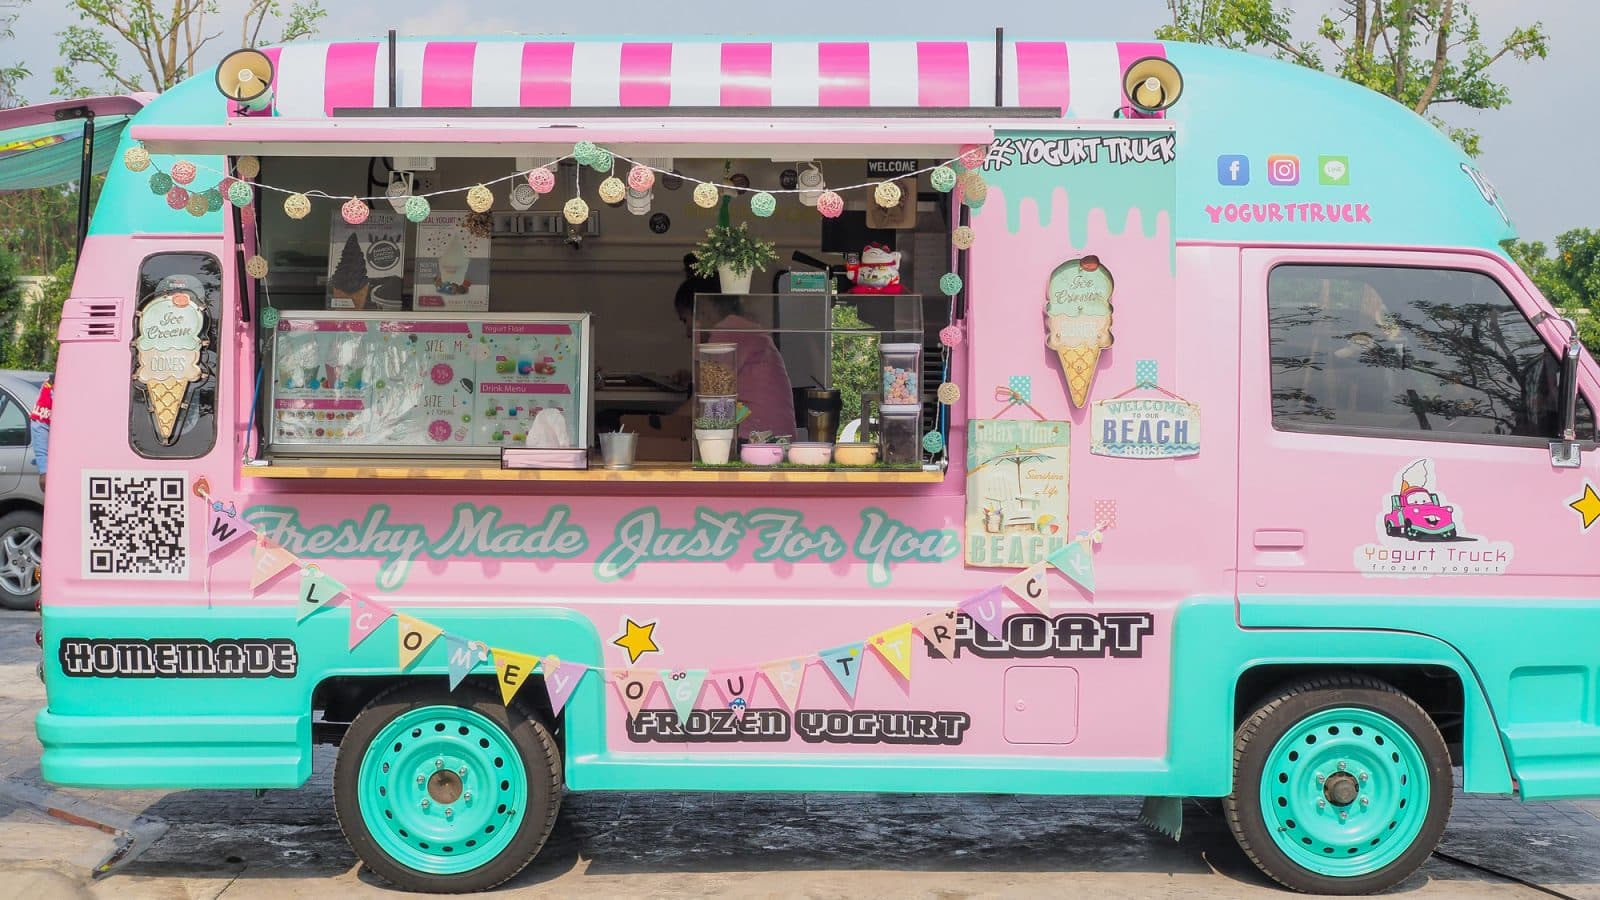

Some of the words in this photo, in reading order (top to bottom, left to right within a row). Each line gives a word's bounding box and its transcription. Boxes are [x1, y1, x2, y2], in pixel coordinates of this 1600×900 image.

[1102, 134, 1175, 165] TRUCK
[869, 161, 916, 172] WELCOME
[1205, 202, 1372, 224] YOGURTTRUCK
[160, 311, 185, 327] Ice
[146, 325, 193, 340] Cream
[484, 325, 506, 334] Yogurt
[508, 325, 525, 333] Float
[424, 340, 444, 353] SIZE
[453, 341, 463, 353] M
[151, 356, 186, 372] CONES
[482, 384, 501, 393] Drink
[501, 384, 527, 393] Menu
[423, 394, 442, 408] SIZE
[452, 394, 457, 408] L
[1108, 400, 1187, 417] WELCOME
[1103, 419, 1189, 444] BEACH
[243, 507, 426, 589] Freshy
[435, 505, 584, 556] Made
[596, 509, 747, 579] Just
[750, 510, 844, 560] For
[857, 510, 958, 586] You
[1365, 548, 1436, 564] Yogurt
[1446, 548, 1507, 563] Truck
[1372, 563, 1428, 573] frozen
[1441, 564, 1499, 575] yogurt
[62, 641, 297, 676] HOMEMADE
[629, 710, 789, 740] FROZEN
[798, 711, 968, 742] YOGURT
